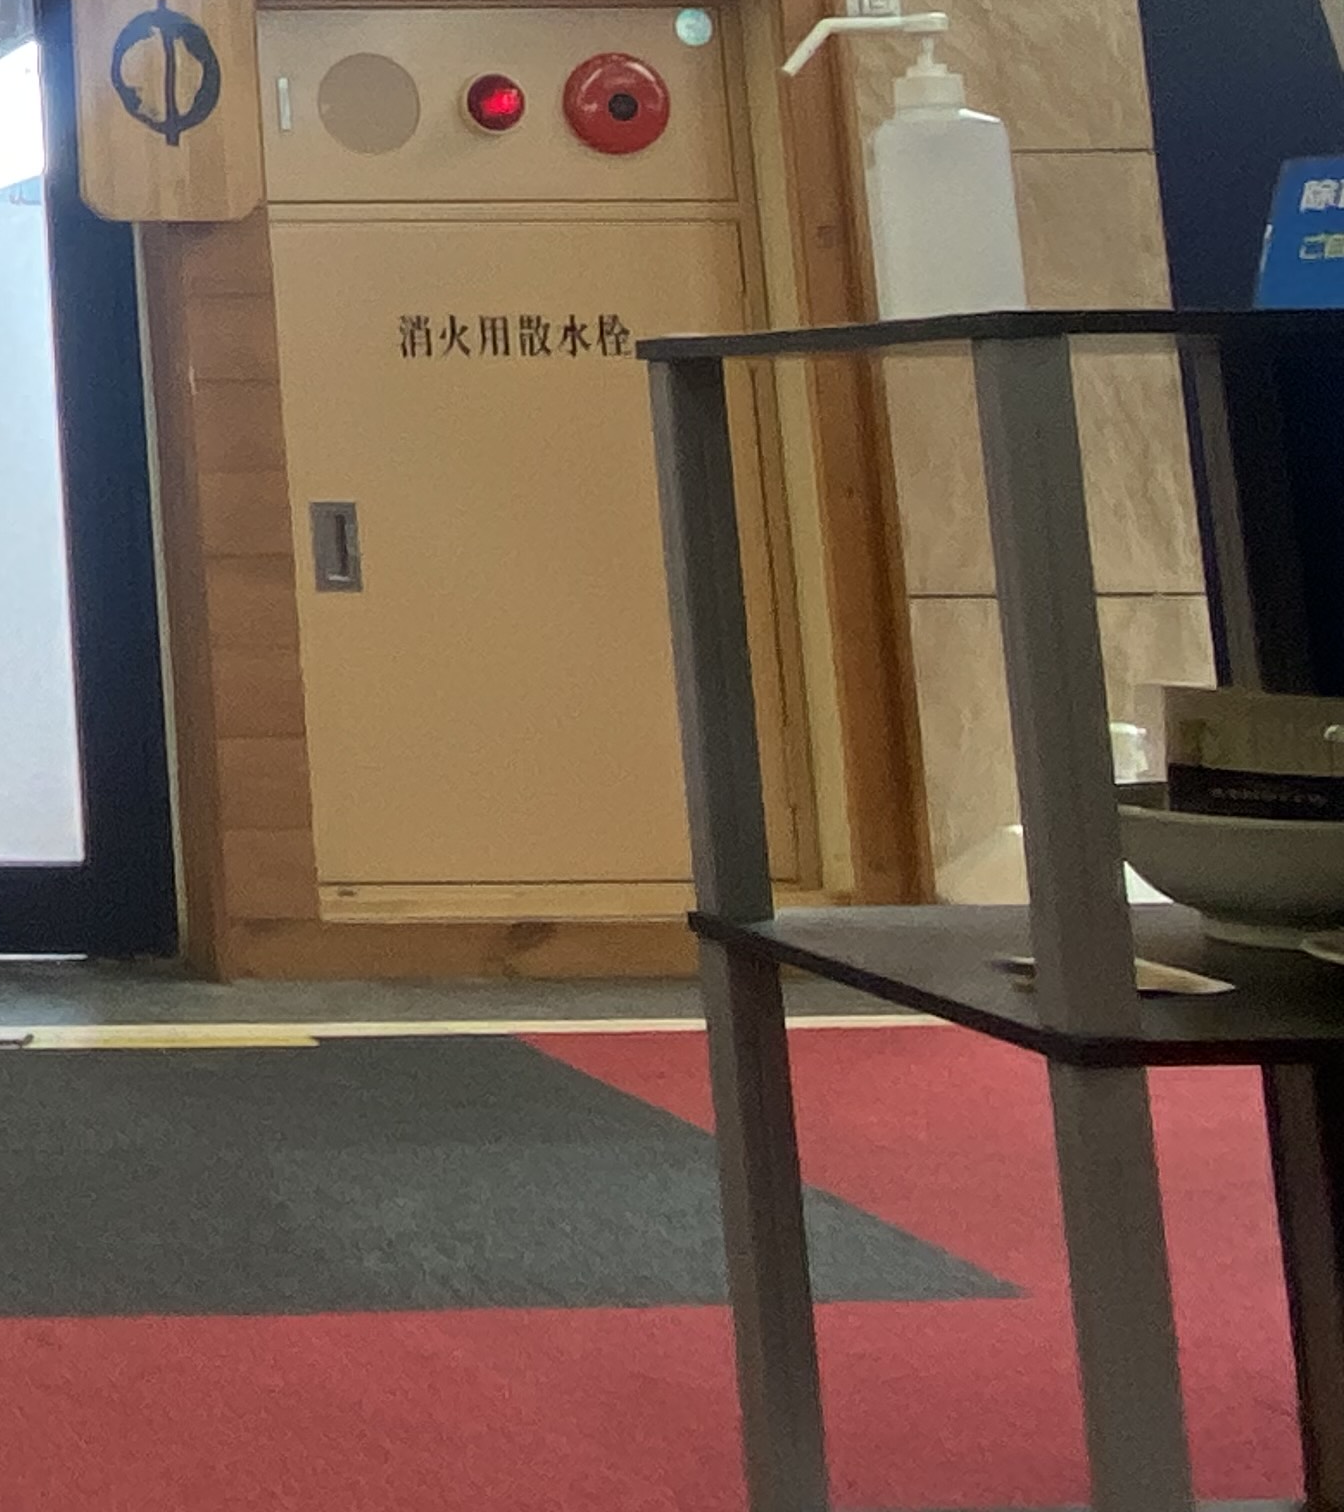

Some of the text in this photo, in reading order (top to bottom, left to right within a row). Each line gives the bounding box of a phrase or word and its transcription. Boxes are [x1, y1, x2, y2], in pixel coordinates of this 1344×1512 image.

[399, 314, 631, 359] 消火用散水栓
